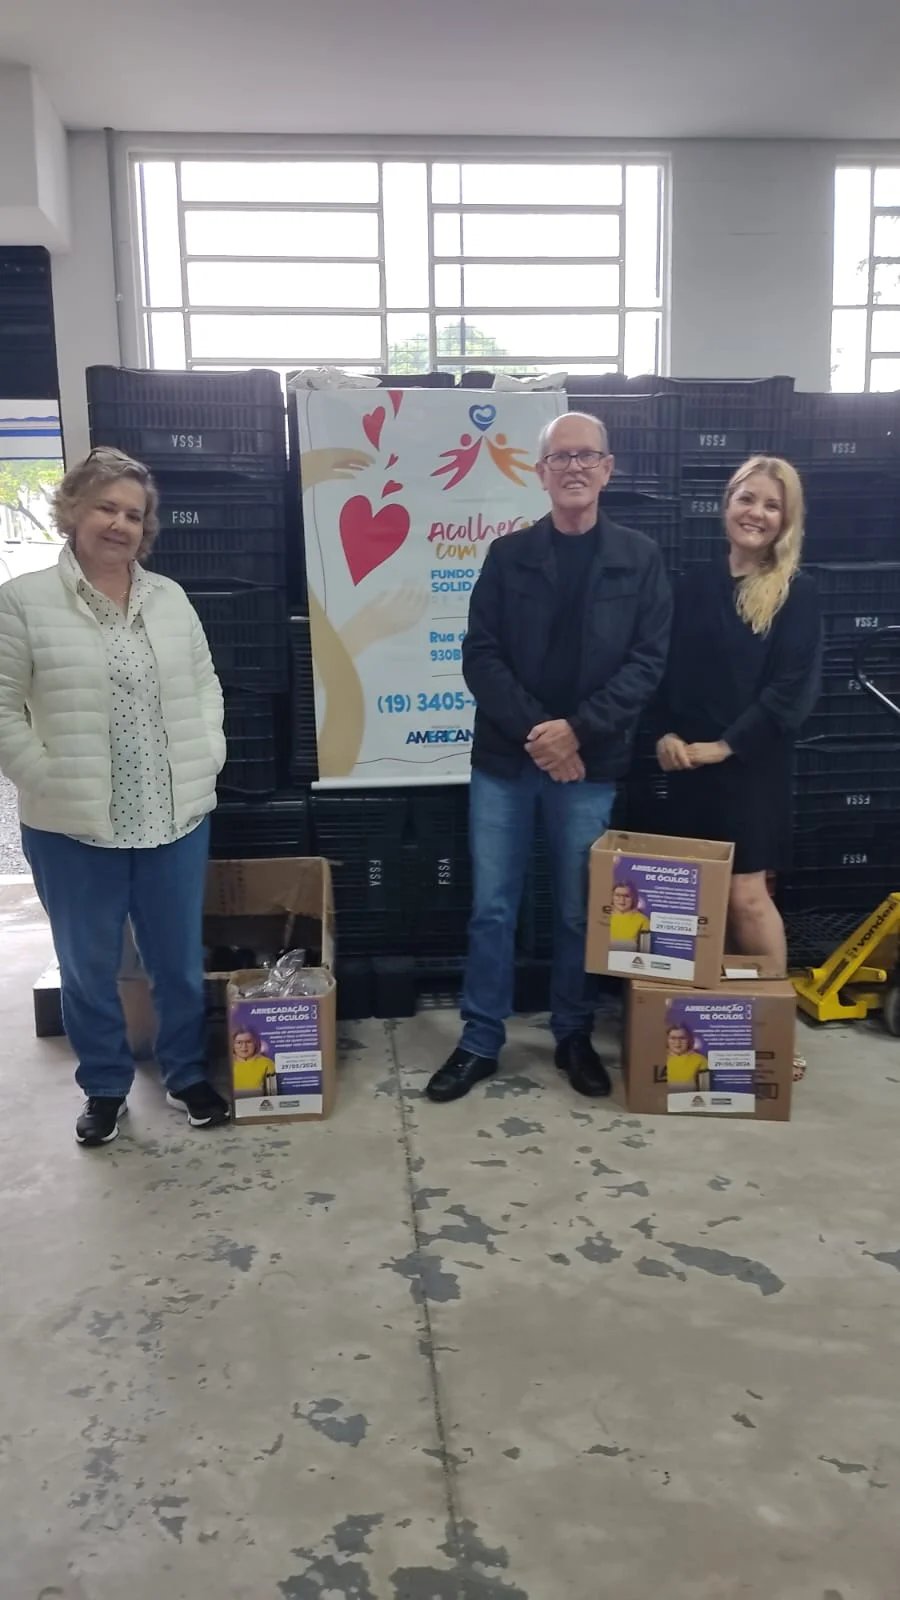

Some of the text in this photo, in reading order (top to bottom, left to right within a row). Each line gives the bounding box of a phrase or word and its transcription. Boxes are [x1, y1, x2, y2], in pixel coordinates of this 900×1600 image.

[171, 434, 203, 448] FSSA
[699, 433, 727, 447] FSSA
[691, 501, 719, 513] FSSA
[172, 511, 200, 524] FSSA
[431, 568, 475, 580] FUNDO
[431, 581, 473, 593] SOLID
[855, 616, 879, 628] FSSA
[430, 631, 455, 643] Rua
[377, 691, 477, 713] (19) 3405-
[405, 729, 474, 745] AMERICAN
[842, 853, 868, 865] FSSA
[368, 859, 382, 887] FSSA
[438, 858, 451, 885] FSSA
[251, 1005, 310, 1015] ARRECADAÇÃO
[265, 1013, 310, 1023] DE ÓCULOS
